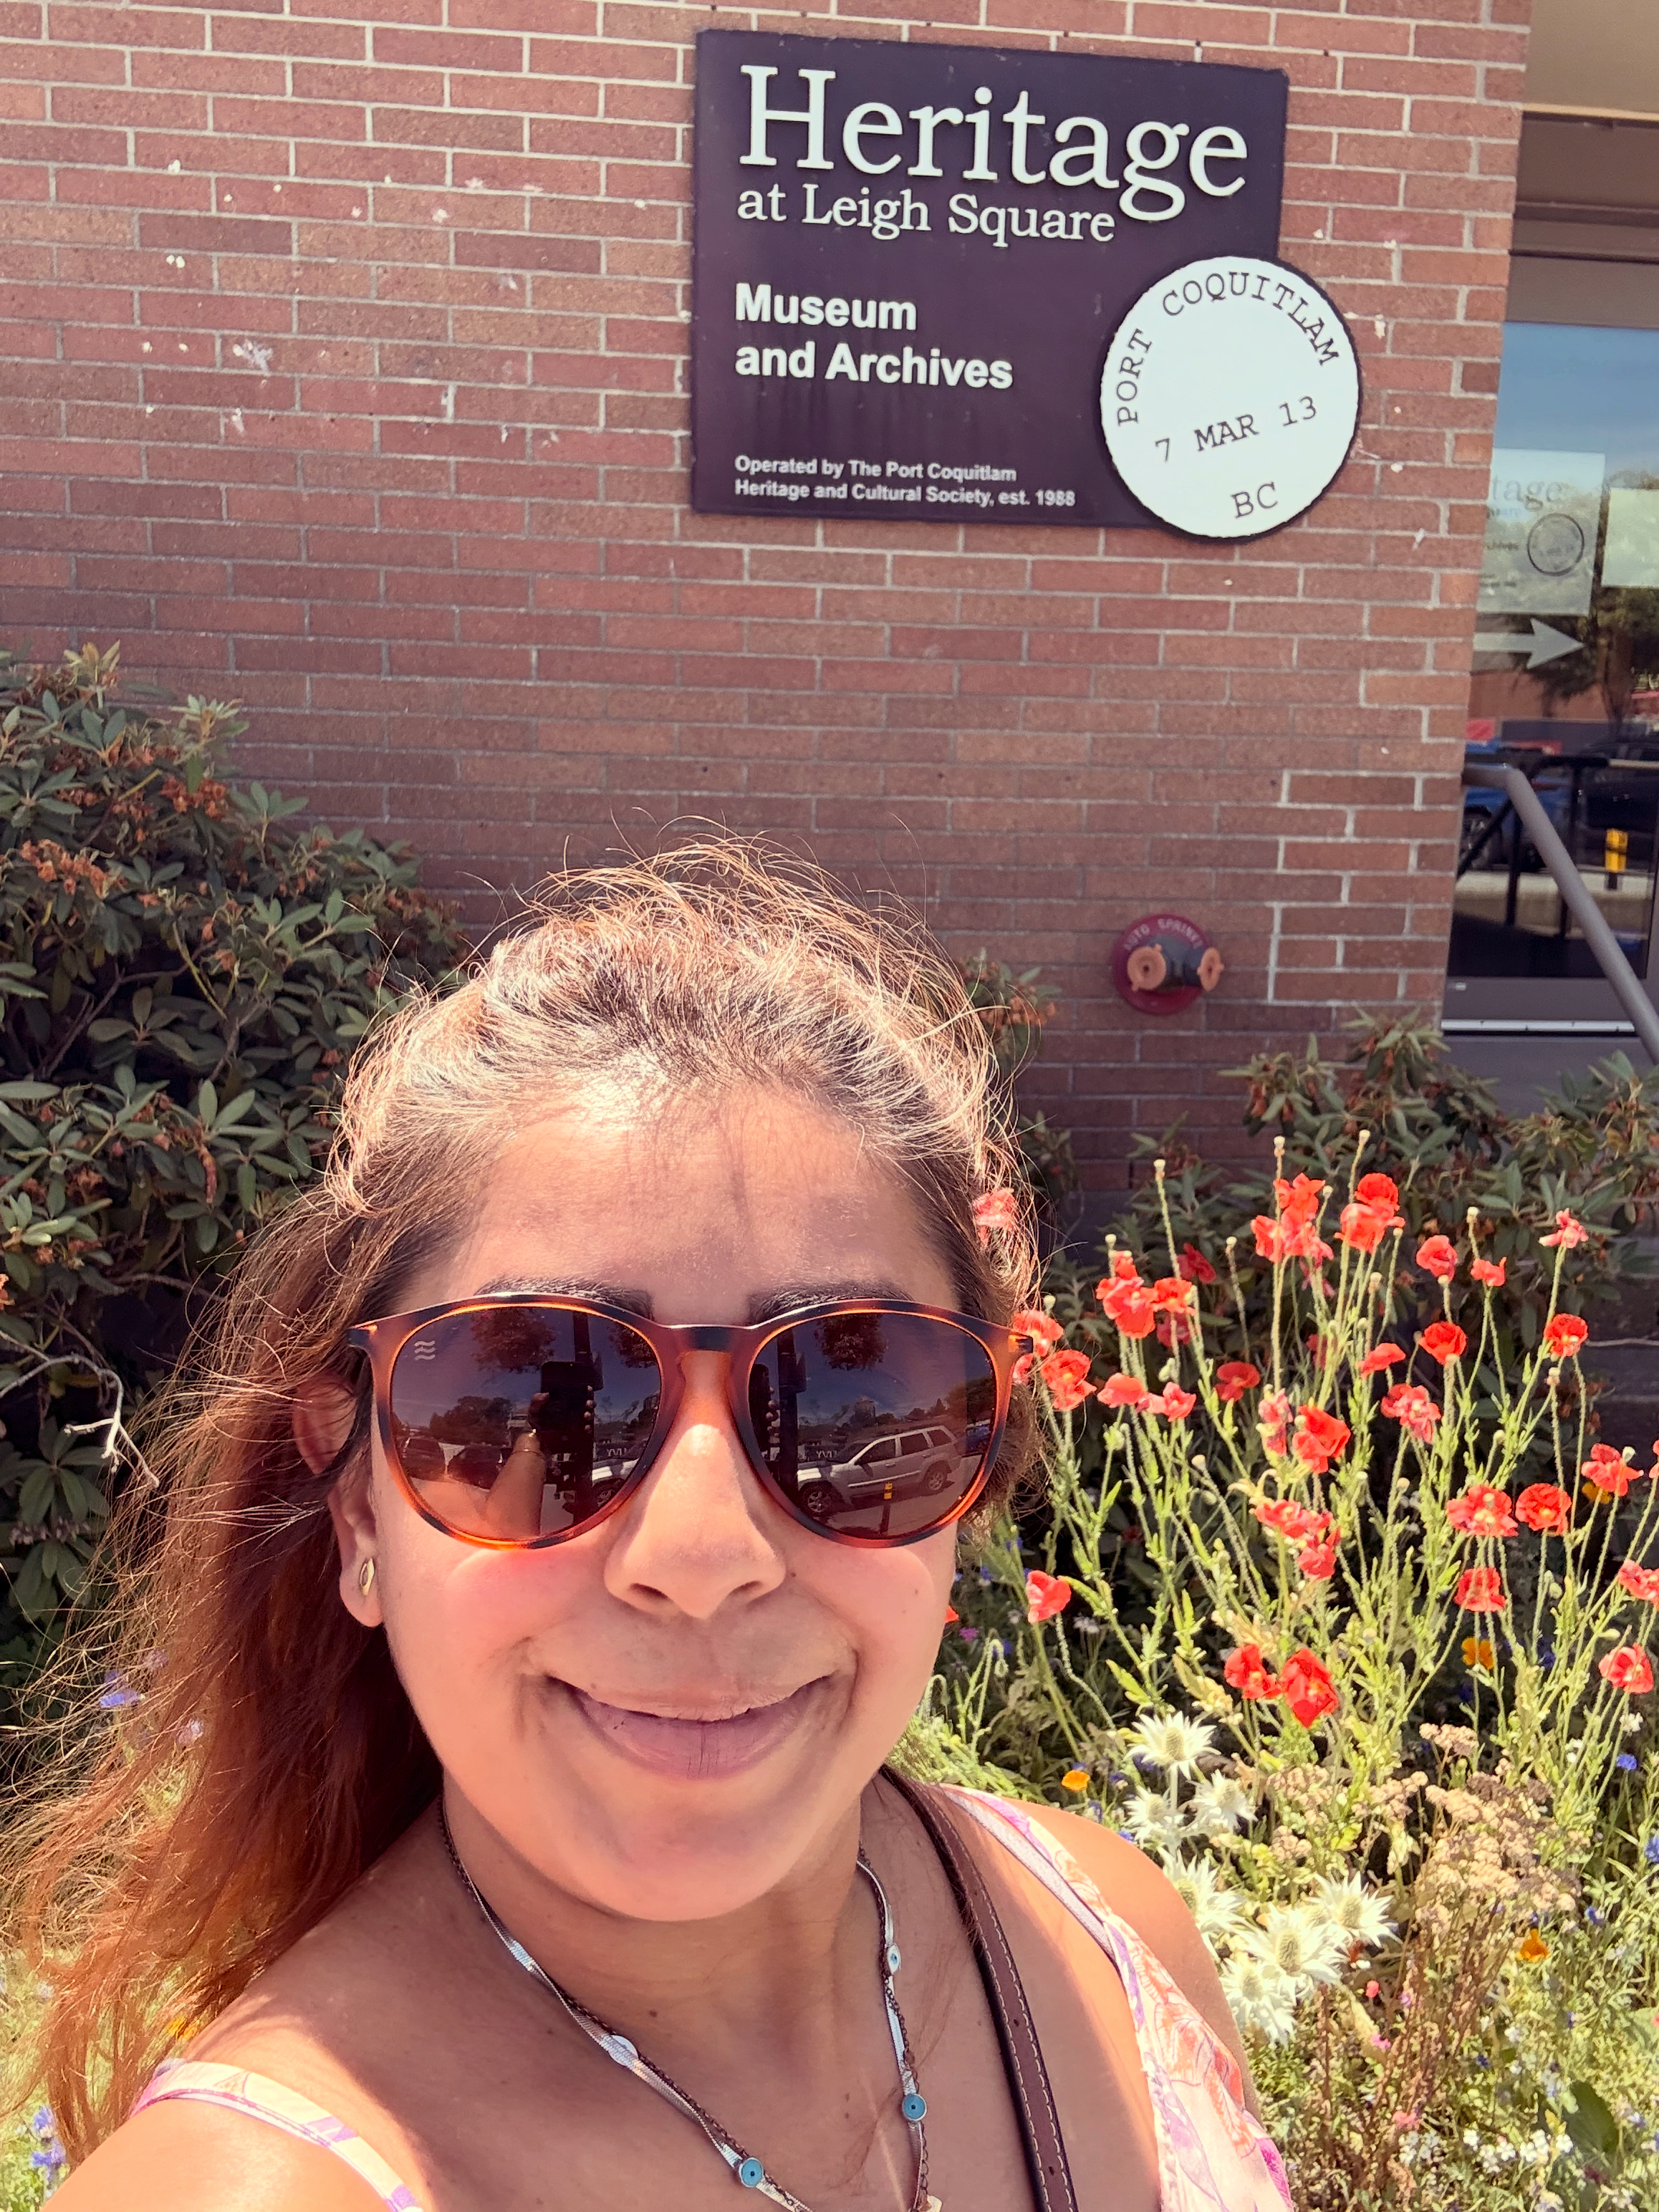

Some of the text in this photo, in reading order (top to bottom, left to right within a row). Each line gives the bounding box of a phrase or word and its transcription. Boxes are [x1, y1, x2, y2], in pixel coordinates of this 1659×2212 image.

[740, 65, 1247, 221] Heritage
[738, 183, 1115, 247] at Leigh Square
[736, 283, 915, 330] Museum
[736, 341, 1012, 388] and Archives
[1117, 271, 1339, 426] PORT COQUITLAM
[1155, 396, 1316, 463] 7 MAR 13
[735, 455, 1016, 483] Operated by The Port Coquitlam
[736, 479, 1075, 507] Heritage and Cultural Society, est. 1988
[1231, 481, 1279, 519] BC
